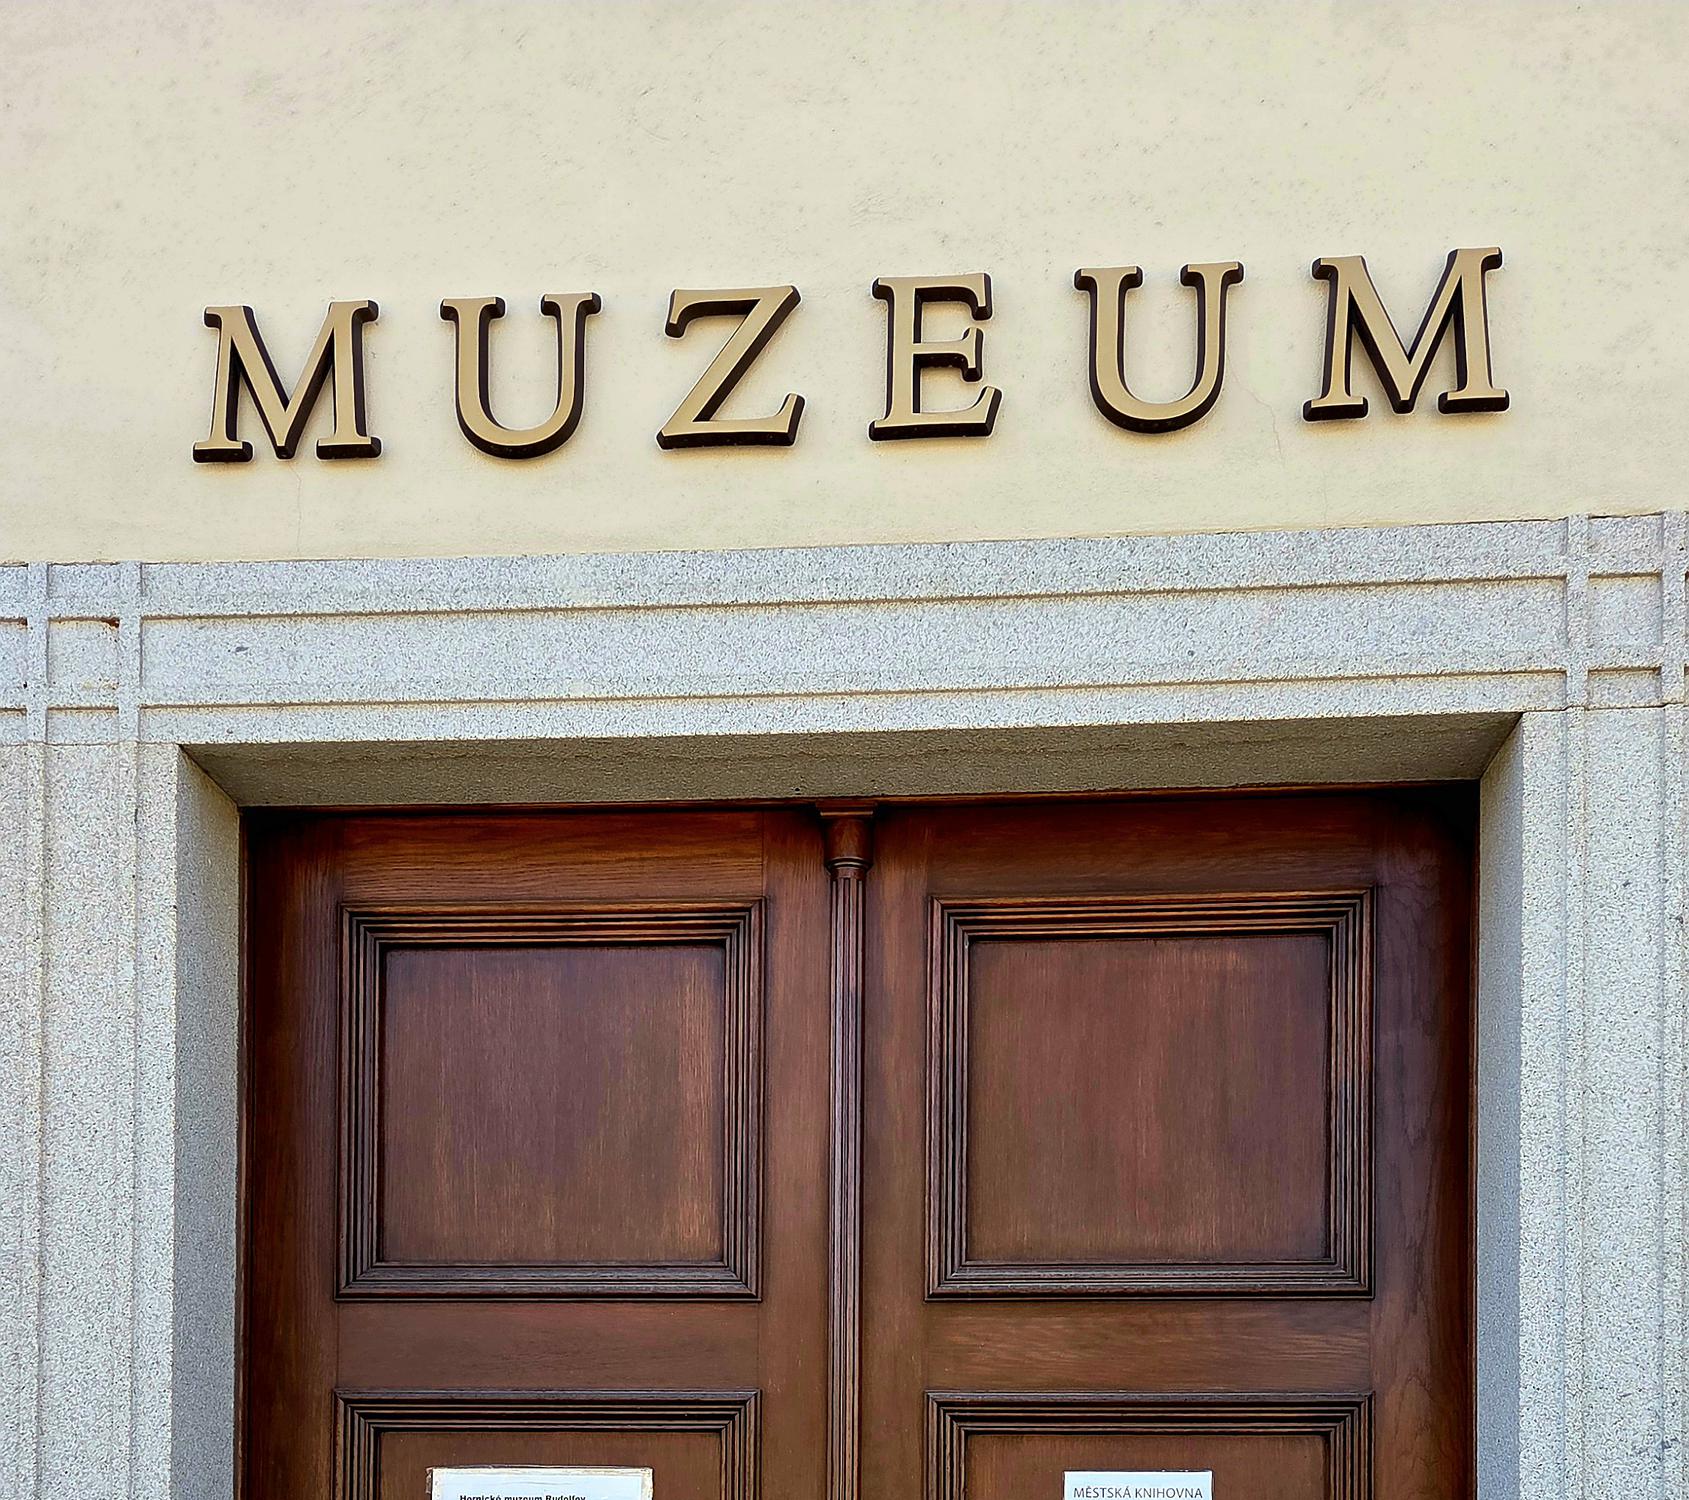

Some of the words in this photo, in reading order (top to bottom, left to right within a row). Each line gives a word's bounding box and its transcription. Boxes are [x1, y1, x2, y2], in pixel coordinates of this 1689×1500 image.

[192, 246, 1511, 464] MUZEUM
[1073, 1486, 1131, 1498] MĚSTSKÁ
[1135, 1488, 1203, 1498] KNIHOVNA
